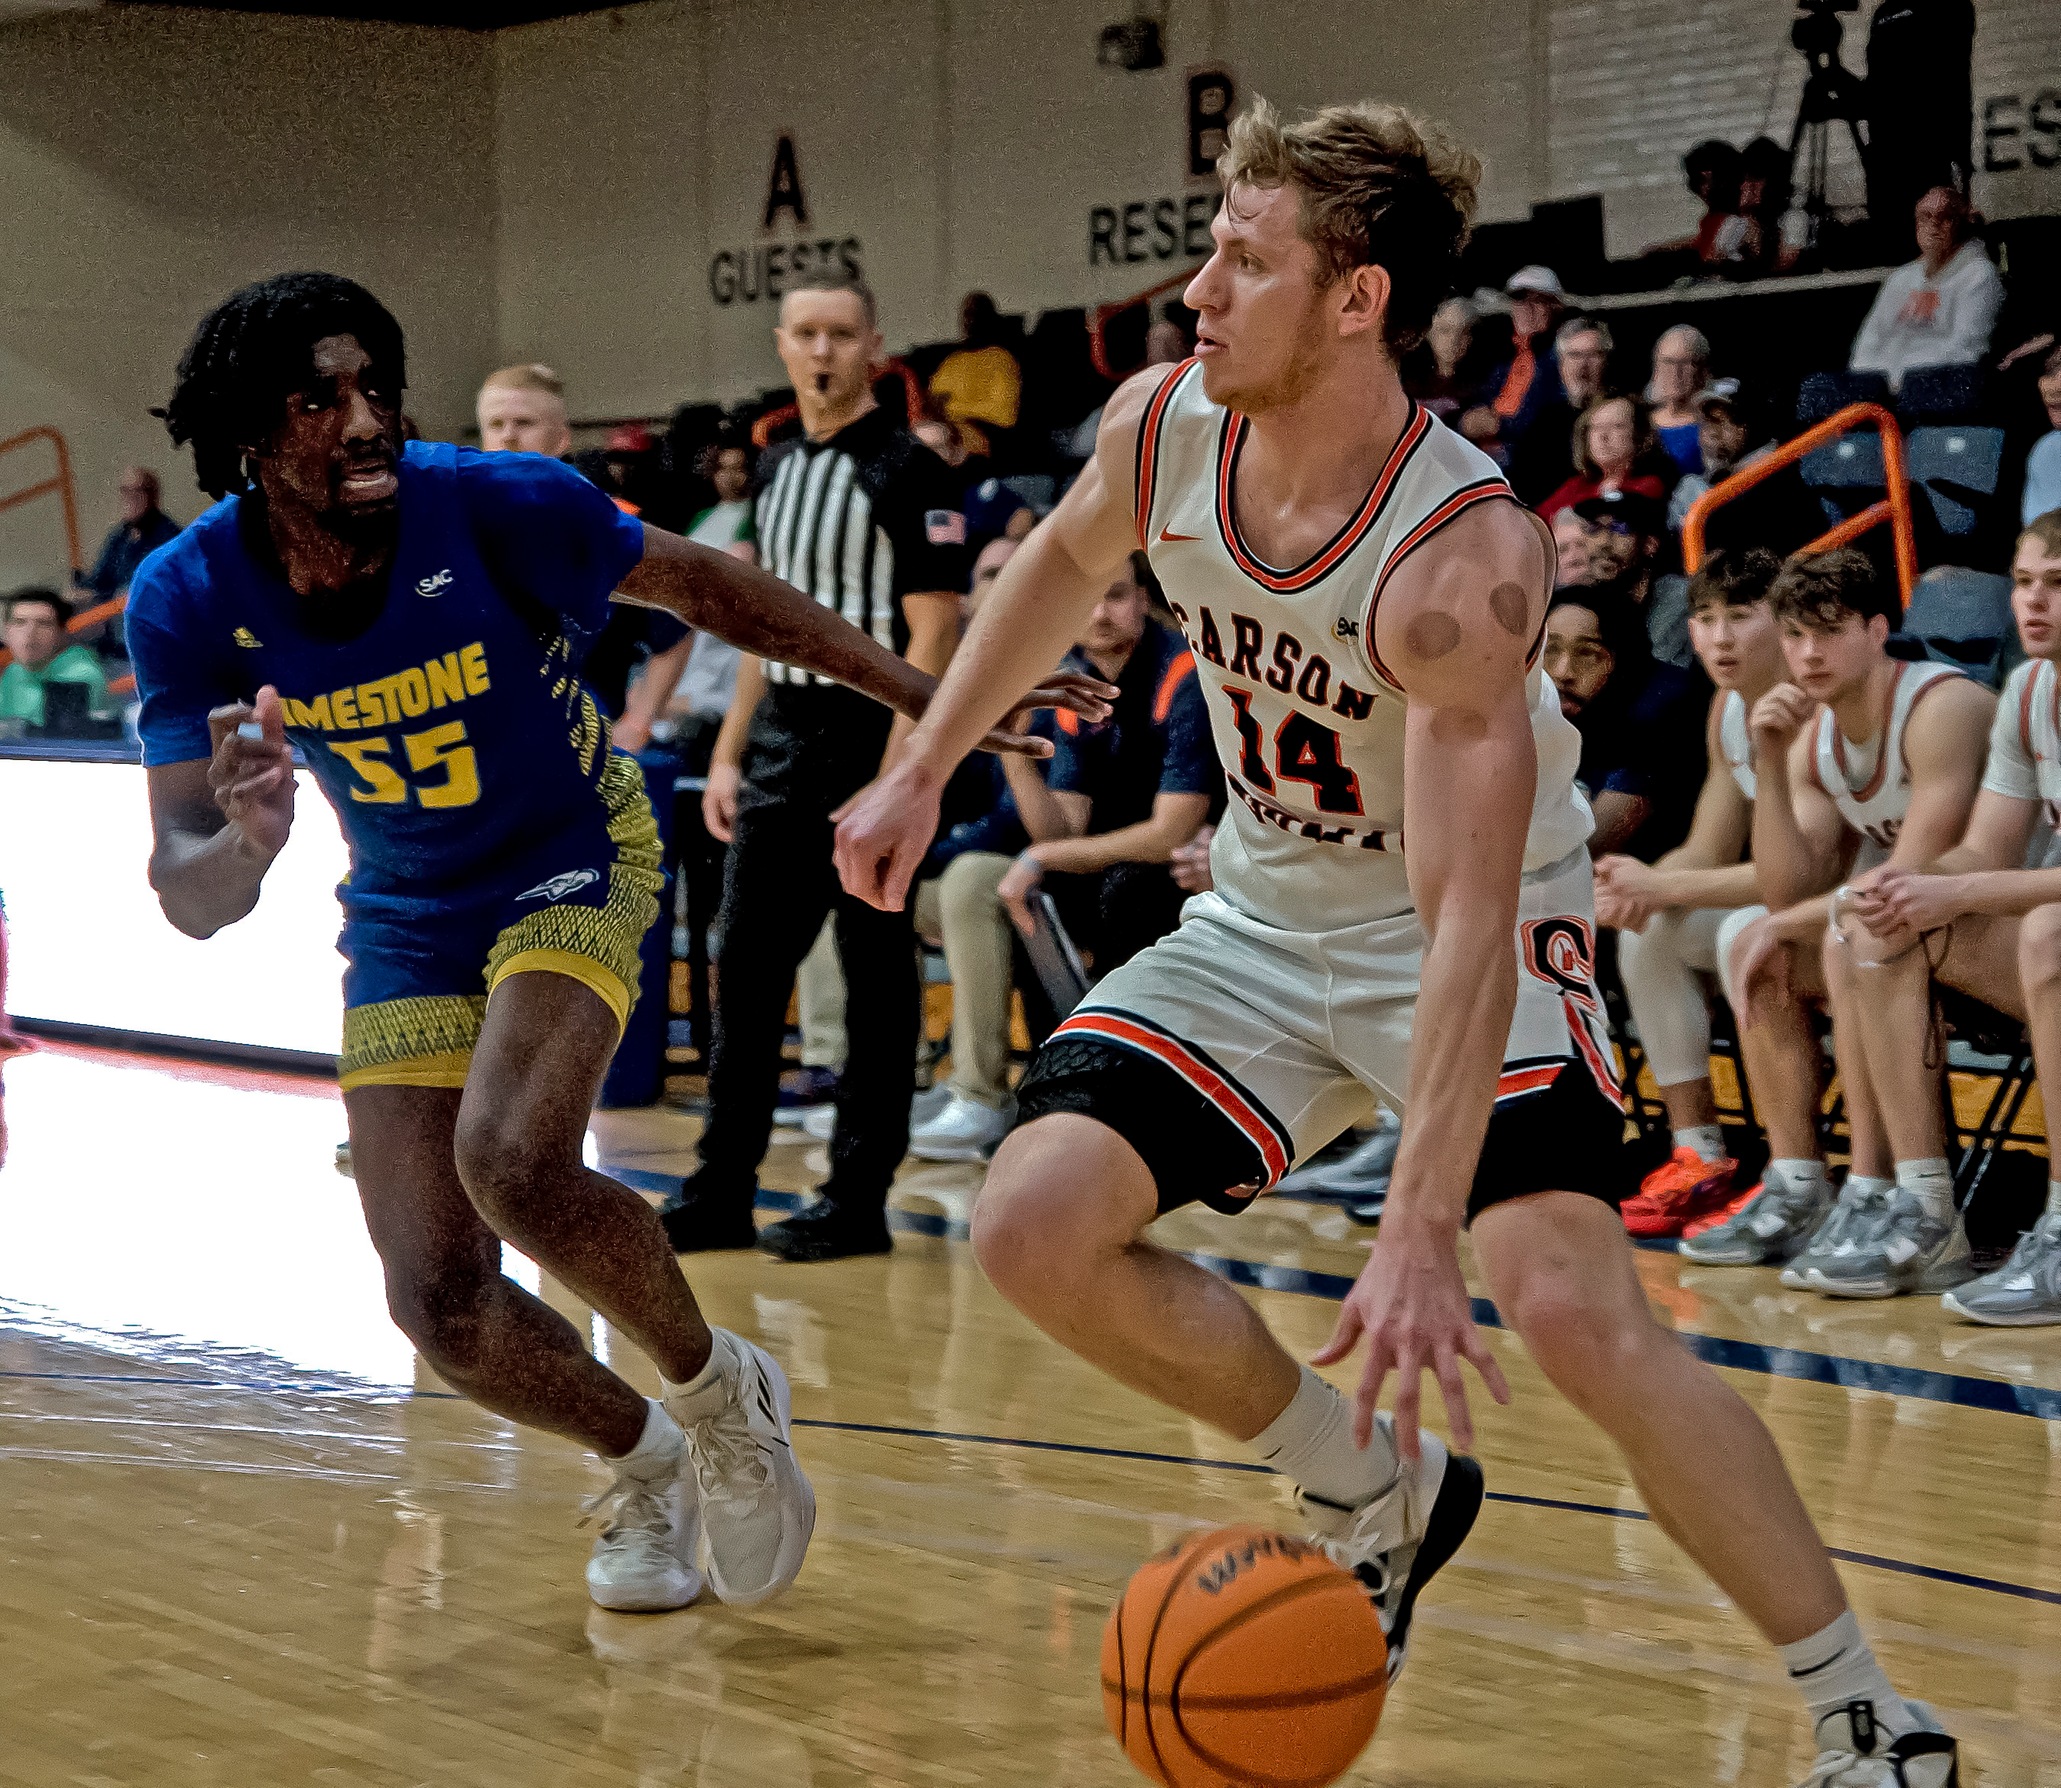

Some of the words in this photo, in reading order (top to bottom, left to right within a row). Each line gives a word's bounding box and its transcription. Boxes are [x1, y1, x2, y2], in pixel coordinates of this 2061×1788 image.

[1186, 68, 1236, 180] B
[763, 131, 810, 230] A
[1089, 193, 1224, 265] RESE
[419, 569, 453, 592] SAC
[279, 641, 491, 731] IMESTONE
[327, 720, 482, 809] 55
[1221, 684, 1367, 817] 14
